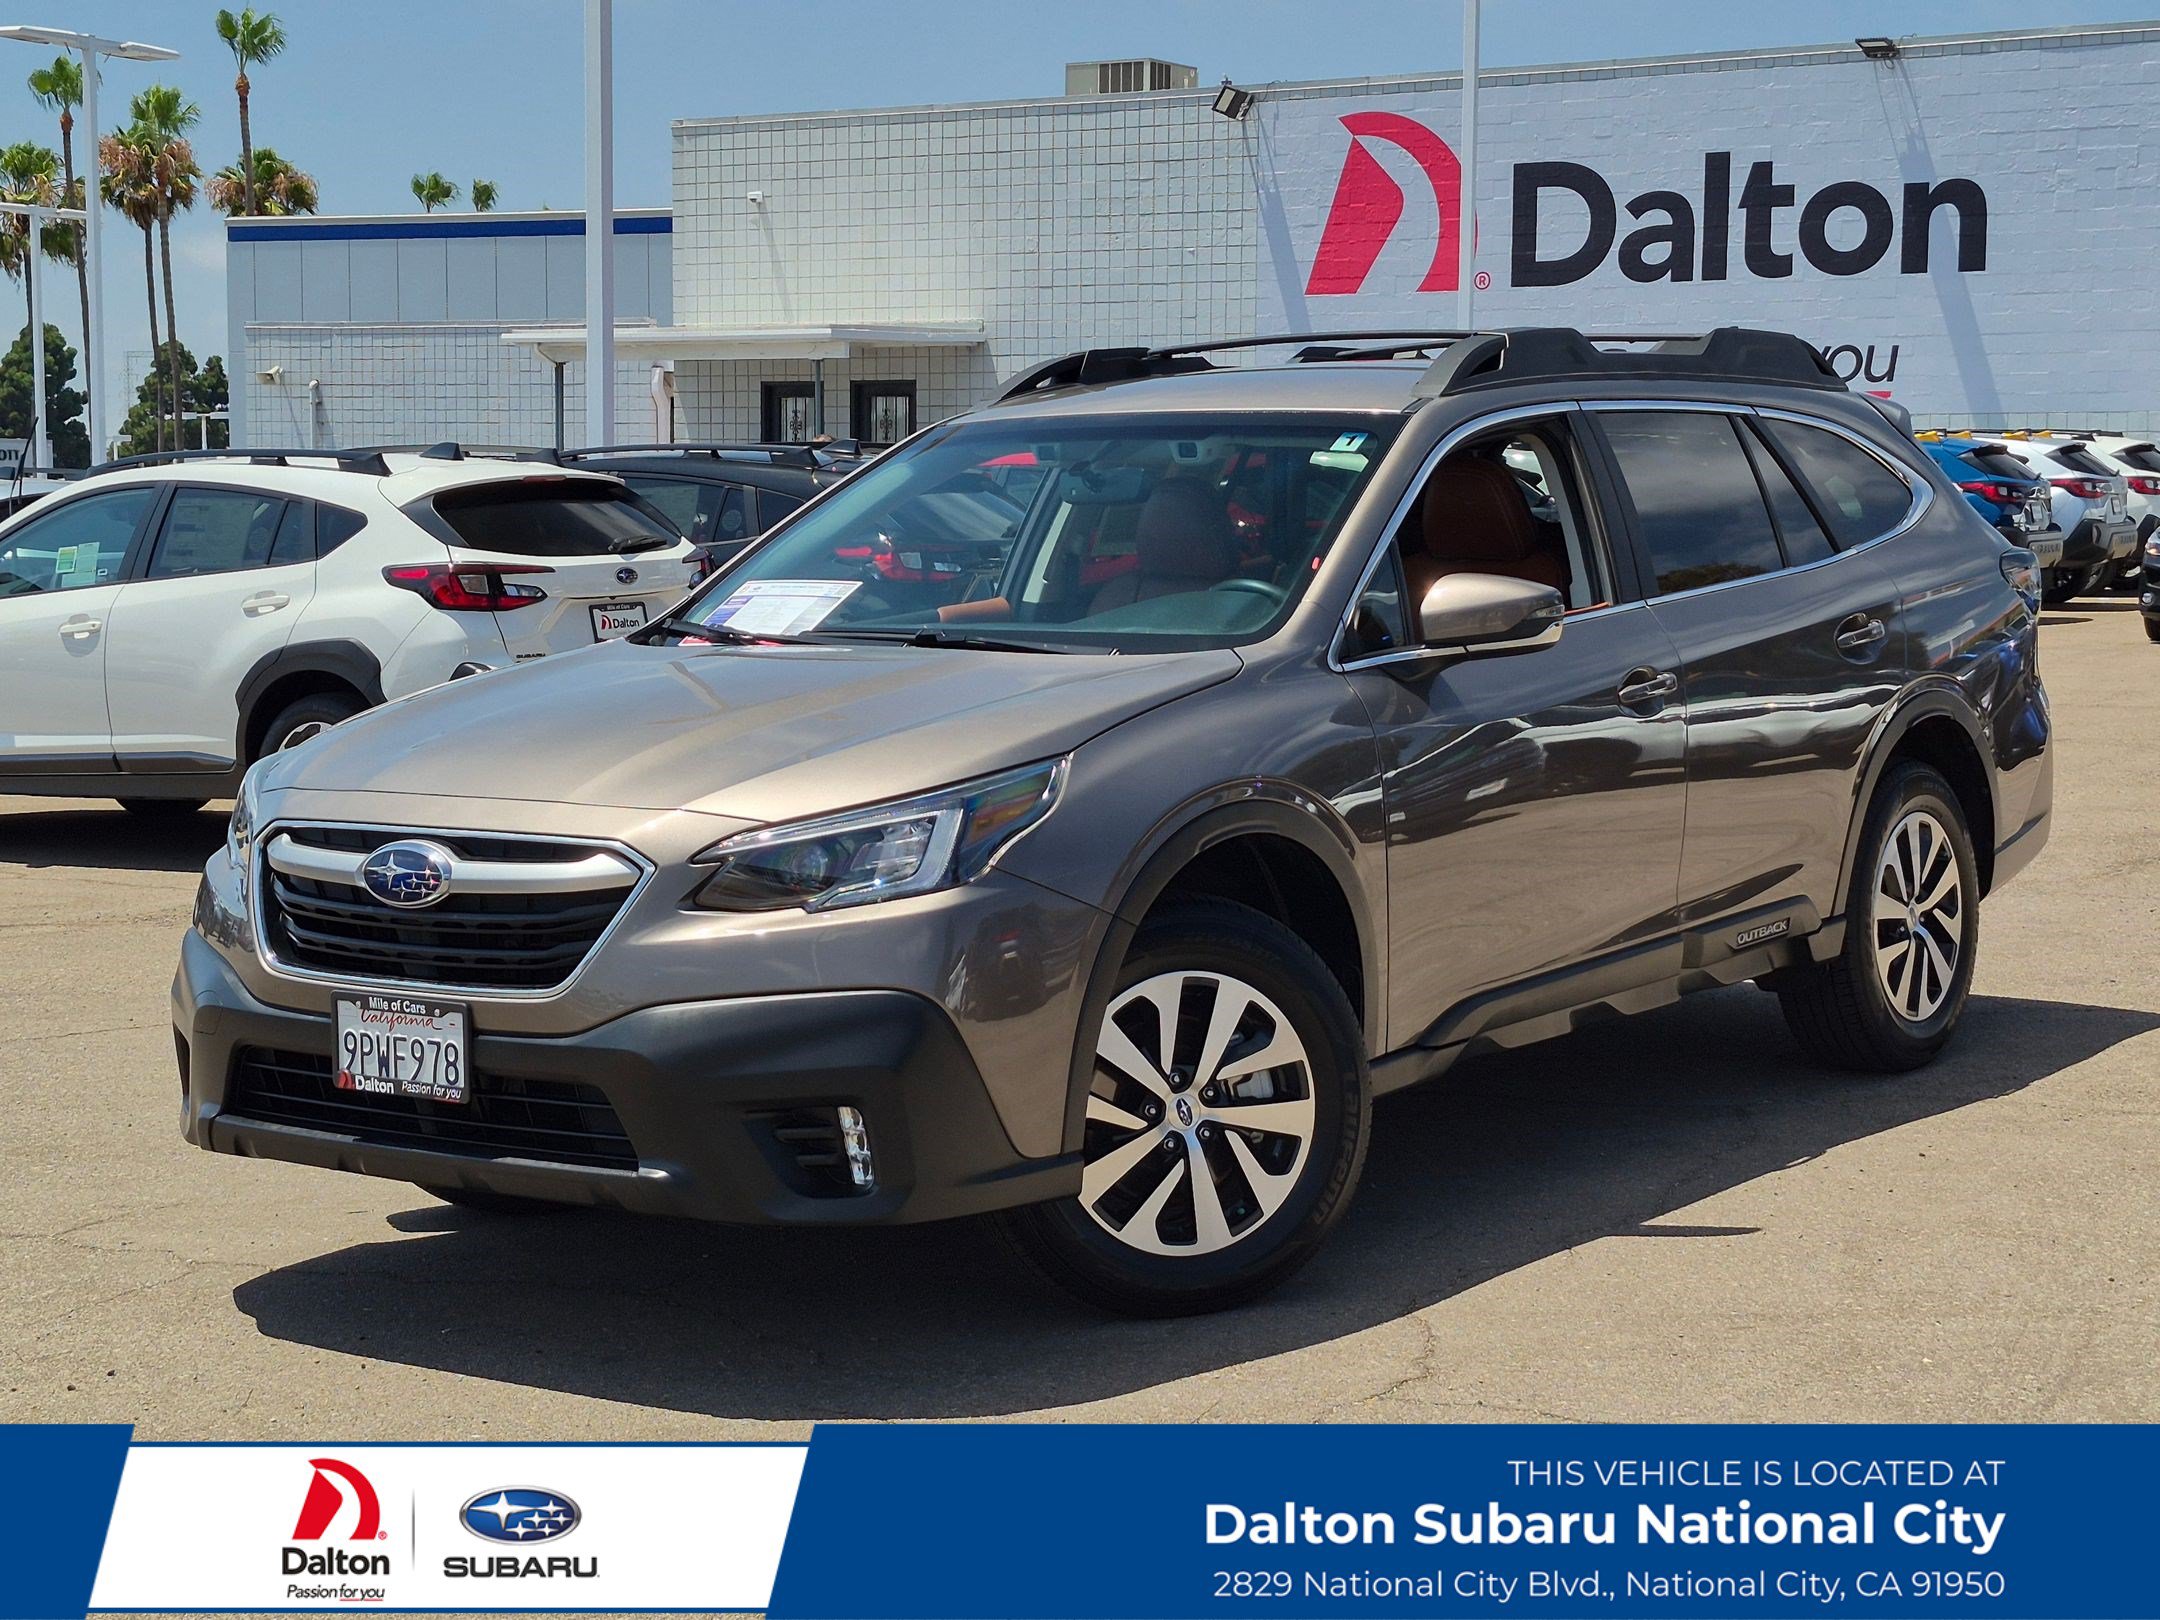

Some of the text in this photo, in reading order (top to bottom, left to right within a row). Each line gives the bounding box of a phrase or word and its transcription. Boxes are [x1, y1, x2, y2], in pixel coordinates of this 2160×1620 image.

[1511, 152, 1988, 288] Dalton
[1820, 344, 1900, 383] ou
[612, 617, 640, 629] Dalton
[1737, 919, 1788, 945] OUTBACK
[368, 996, 427, 1015] Mile of Cars
[360, 1009, 443, 1032] California
[343, 1029, 461, 1087] 9PWF978
[355, 1075, 462, 1099] Dalton Passion for you
